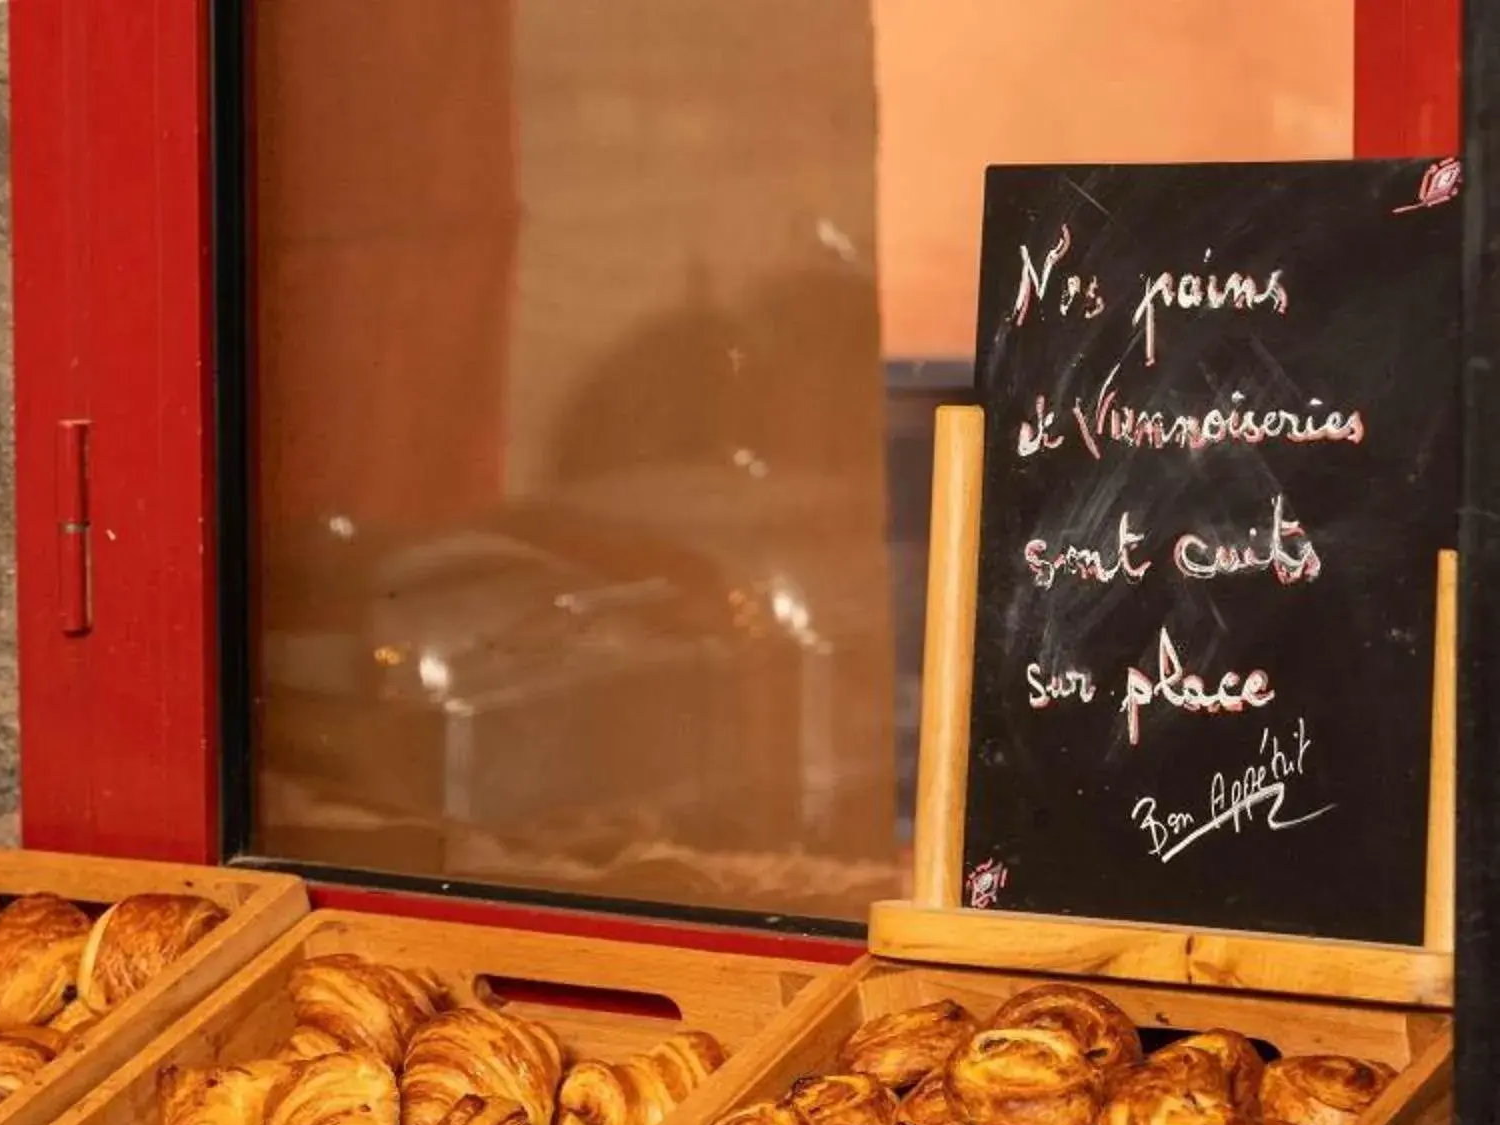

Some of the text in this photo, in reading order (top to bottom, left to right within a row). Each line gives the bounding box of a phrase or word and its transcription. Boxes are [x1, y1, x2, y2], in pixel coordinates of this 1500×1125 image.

[1010, 222, 1289, 367] Nos pains
[1172, 493, 1322, 586] cuits
[1118, 625, 1276, 746] place
[1131, 796, 1195, 856] Bon
